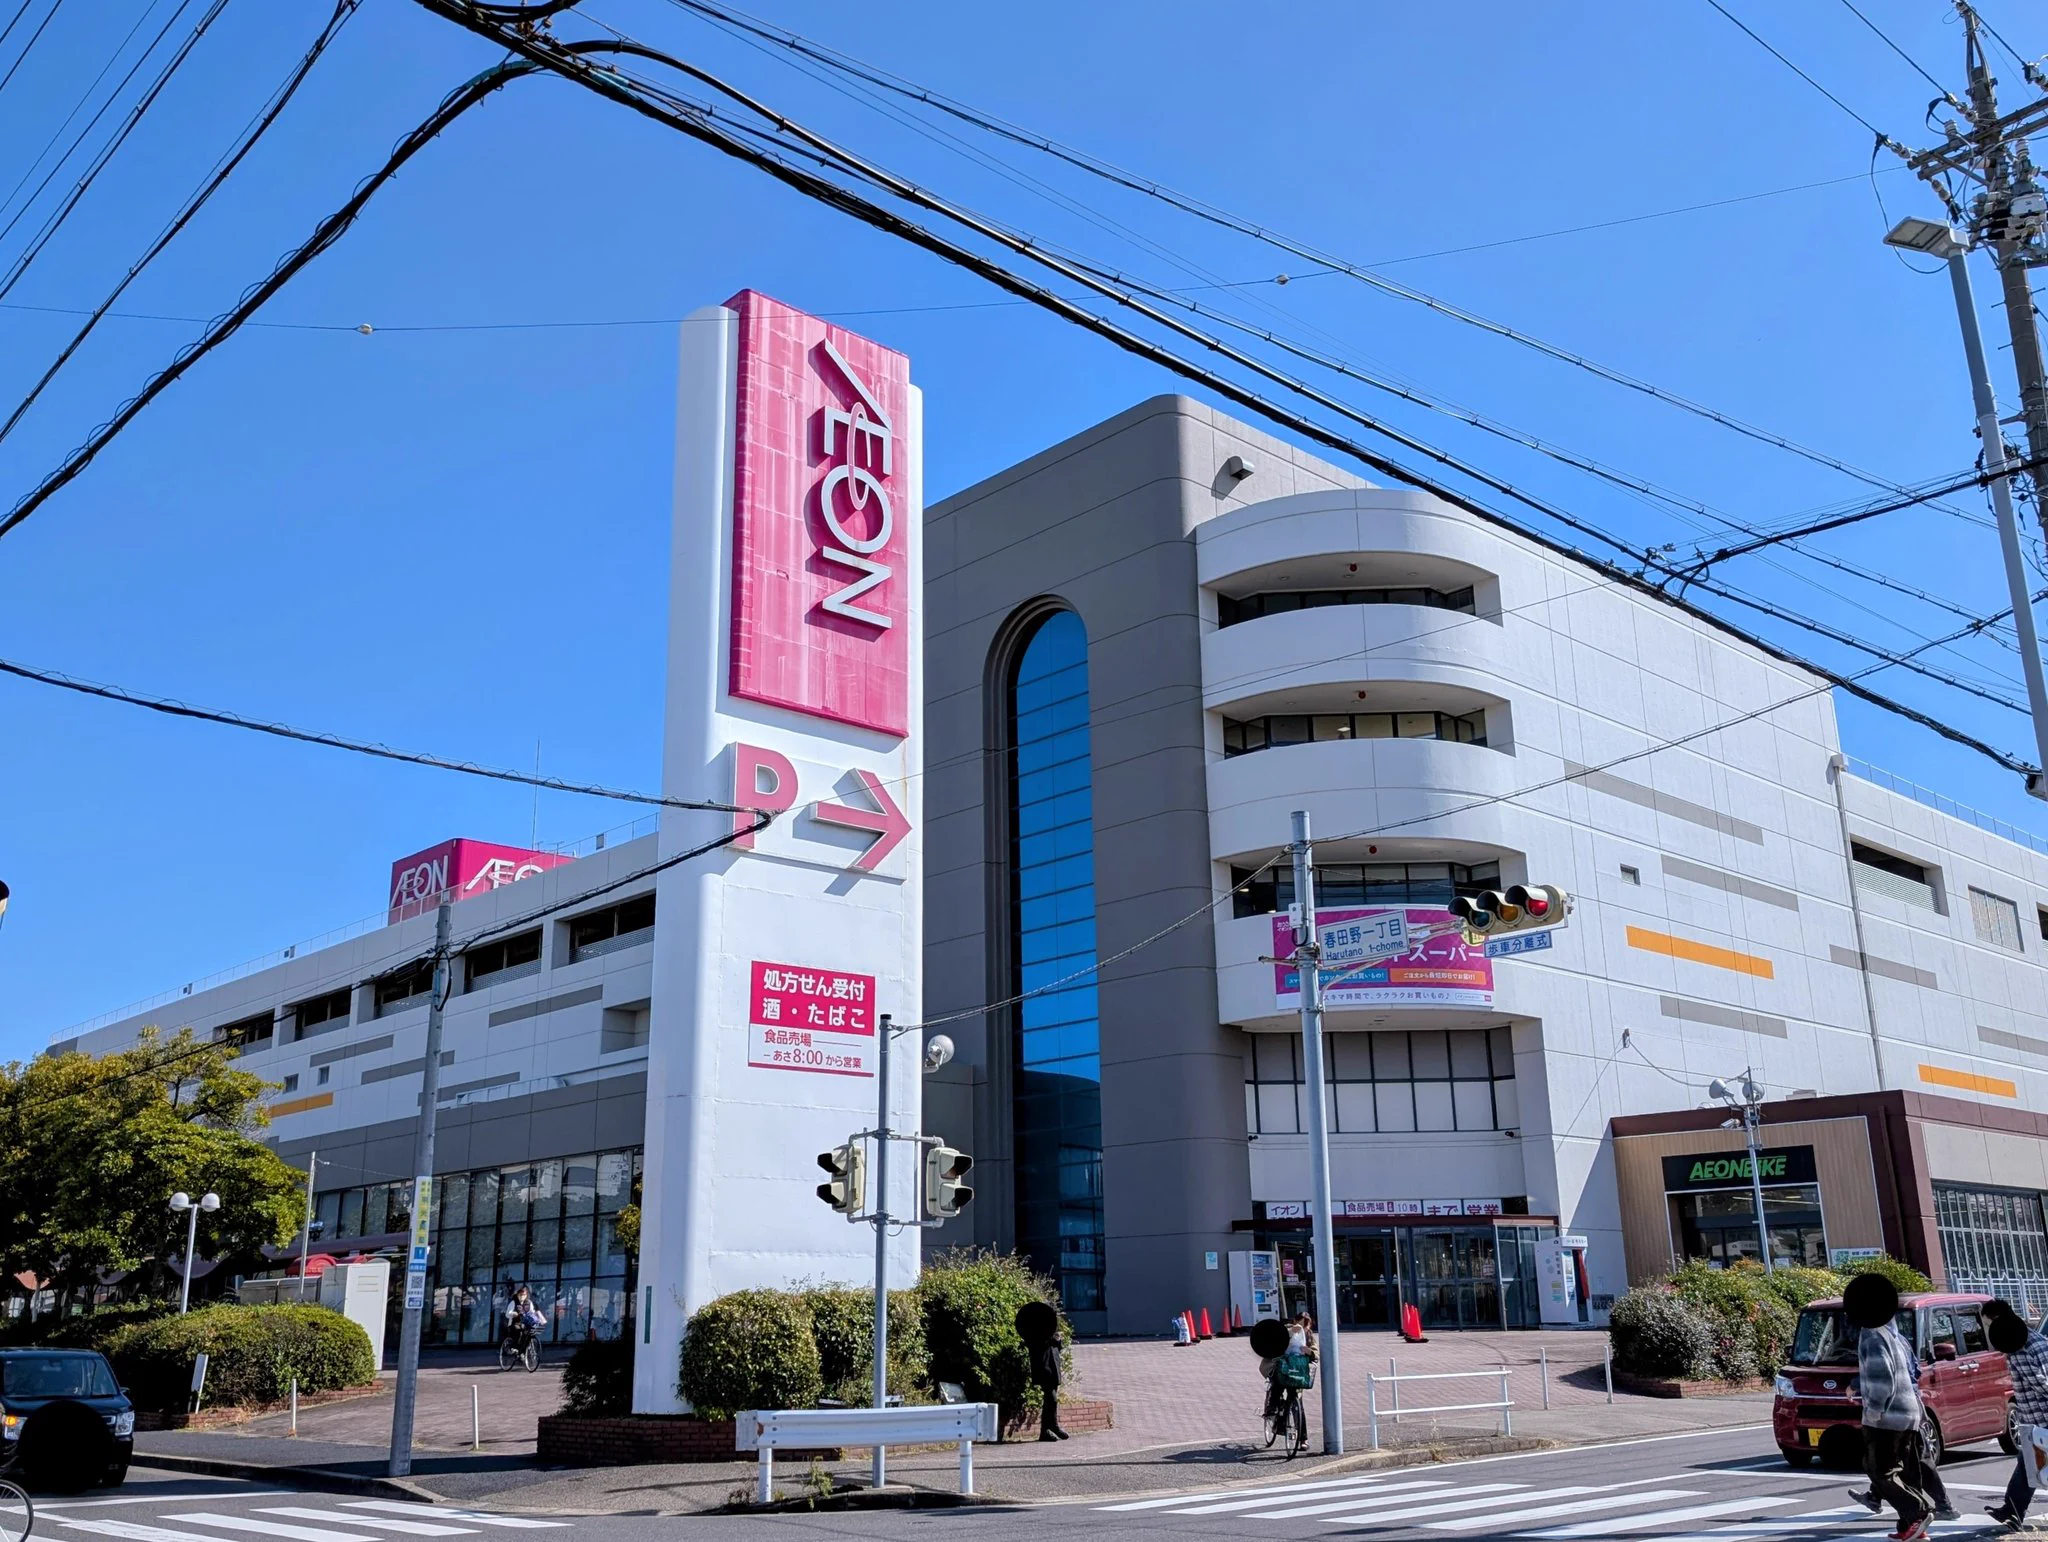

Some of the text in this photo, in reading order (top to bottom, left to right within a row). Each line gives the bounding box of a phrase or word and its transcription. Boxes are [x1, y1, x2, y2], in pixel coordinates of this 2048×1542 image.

[821, 338, 892, 630] AEON
[731, 741, 798, 851] P
[390, 855, 449, 908] AEON
[1324, 919, 1402, 949] 春田野一丁目
[1488, 933, 1548, 954] 歩車分離式
[1326, 940, 1404, 961] Harutano 1-chome
[763, 968, 865, 1002] 処方せん受付
[764, 1029, 812, 1047] 食品売場
[1271, 1205, 1300, 1216] イオン
